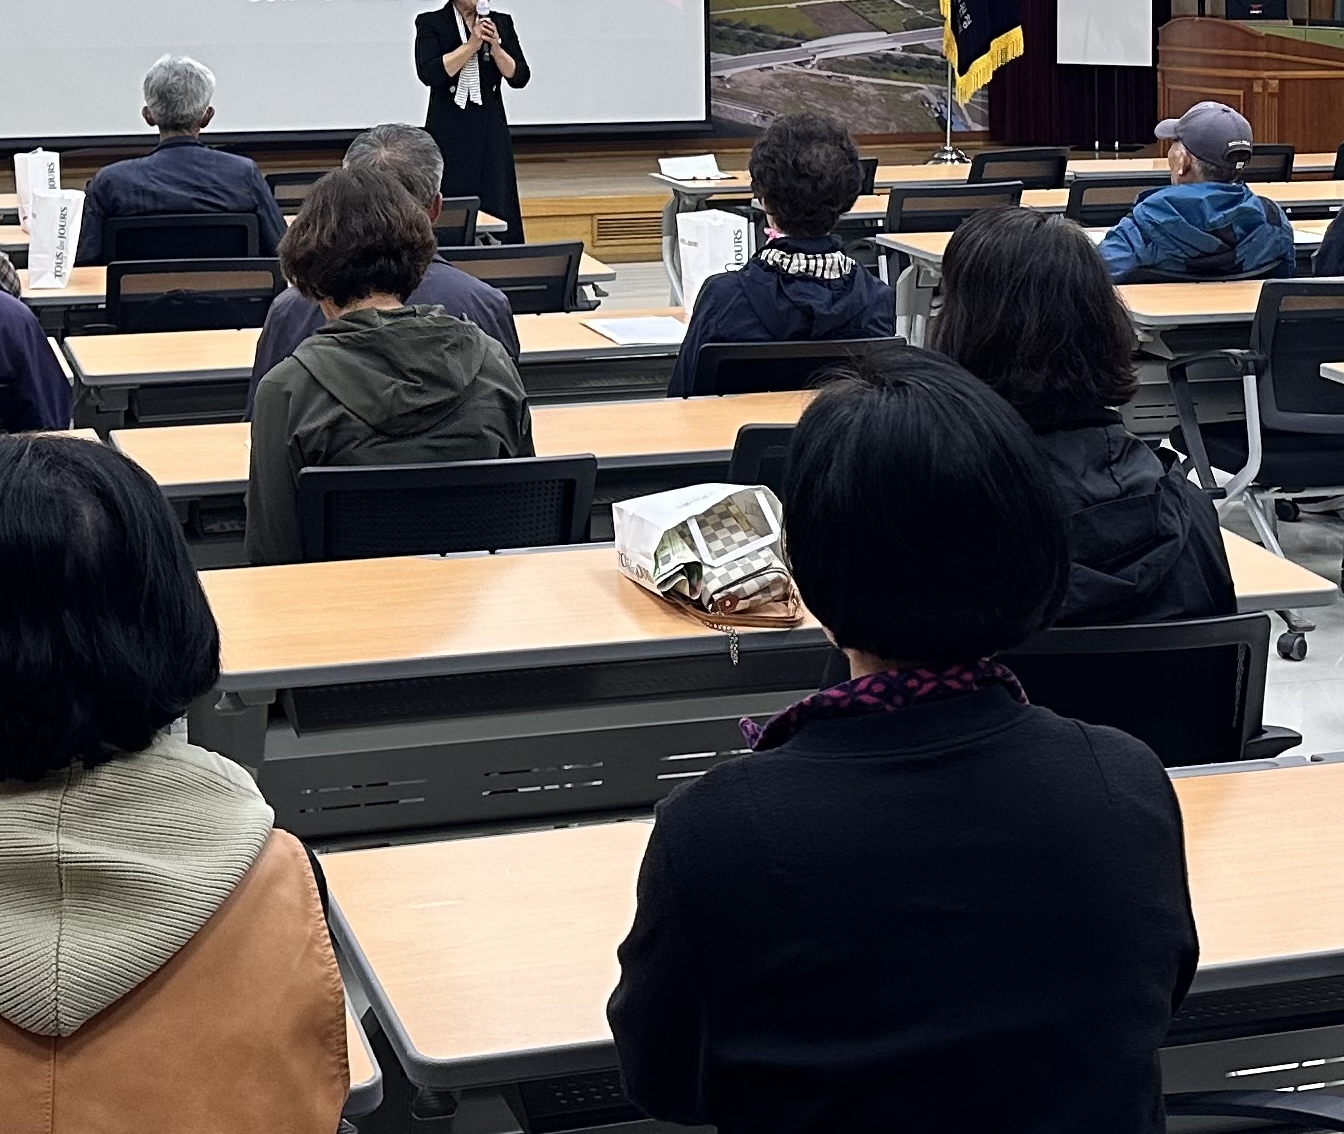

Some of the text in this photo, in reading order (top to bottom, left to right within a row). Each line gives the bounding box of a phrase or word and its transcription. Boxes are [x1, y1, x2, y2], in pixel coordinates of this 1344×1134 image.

[58, 206, 67, 240] JOURS
[733, 228, 744, 265] JOURS
[54, 251, 64, 279] TOUS
